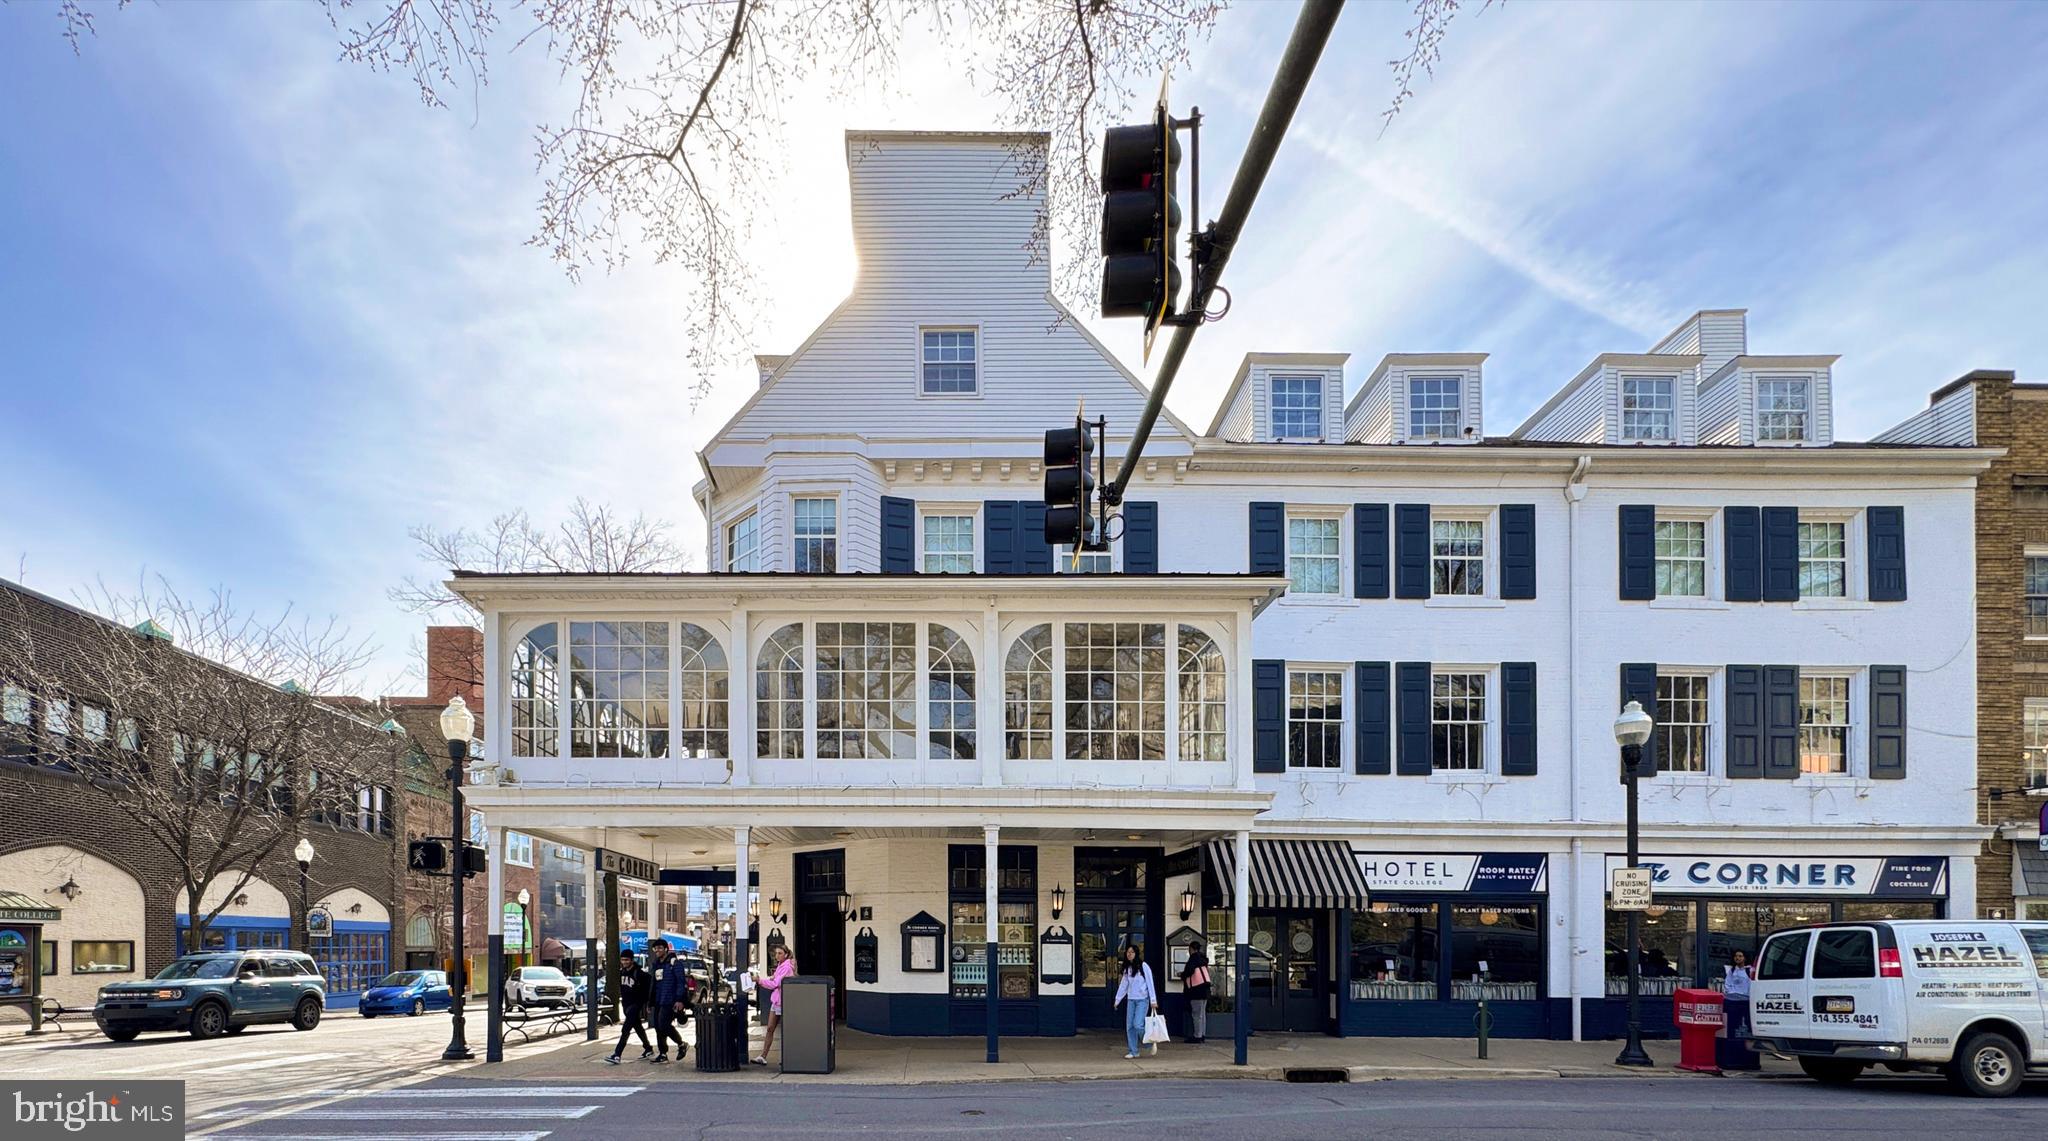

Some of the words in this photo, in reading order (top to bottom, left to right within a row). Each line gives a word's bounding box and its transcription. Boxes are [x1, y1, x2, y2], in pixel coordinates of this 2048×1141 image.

[619, 856, 655, 879] CORNER
[1364, 861, 1453, 877] HOTEL
[1687, 861, 1856, 886] CORNER
[0, 910, 12, 918] TE
[14, 910, 57, 919] COLLEGE
[1912, 946, 2017, 961] HAZEL
[1756, 1002, 1802, 1010] HAZEL
[1812, 1014, 1879, 1024] 814.355.4841
